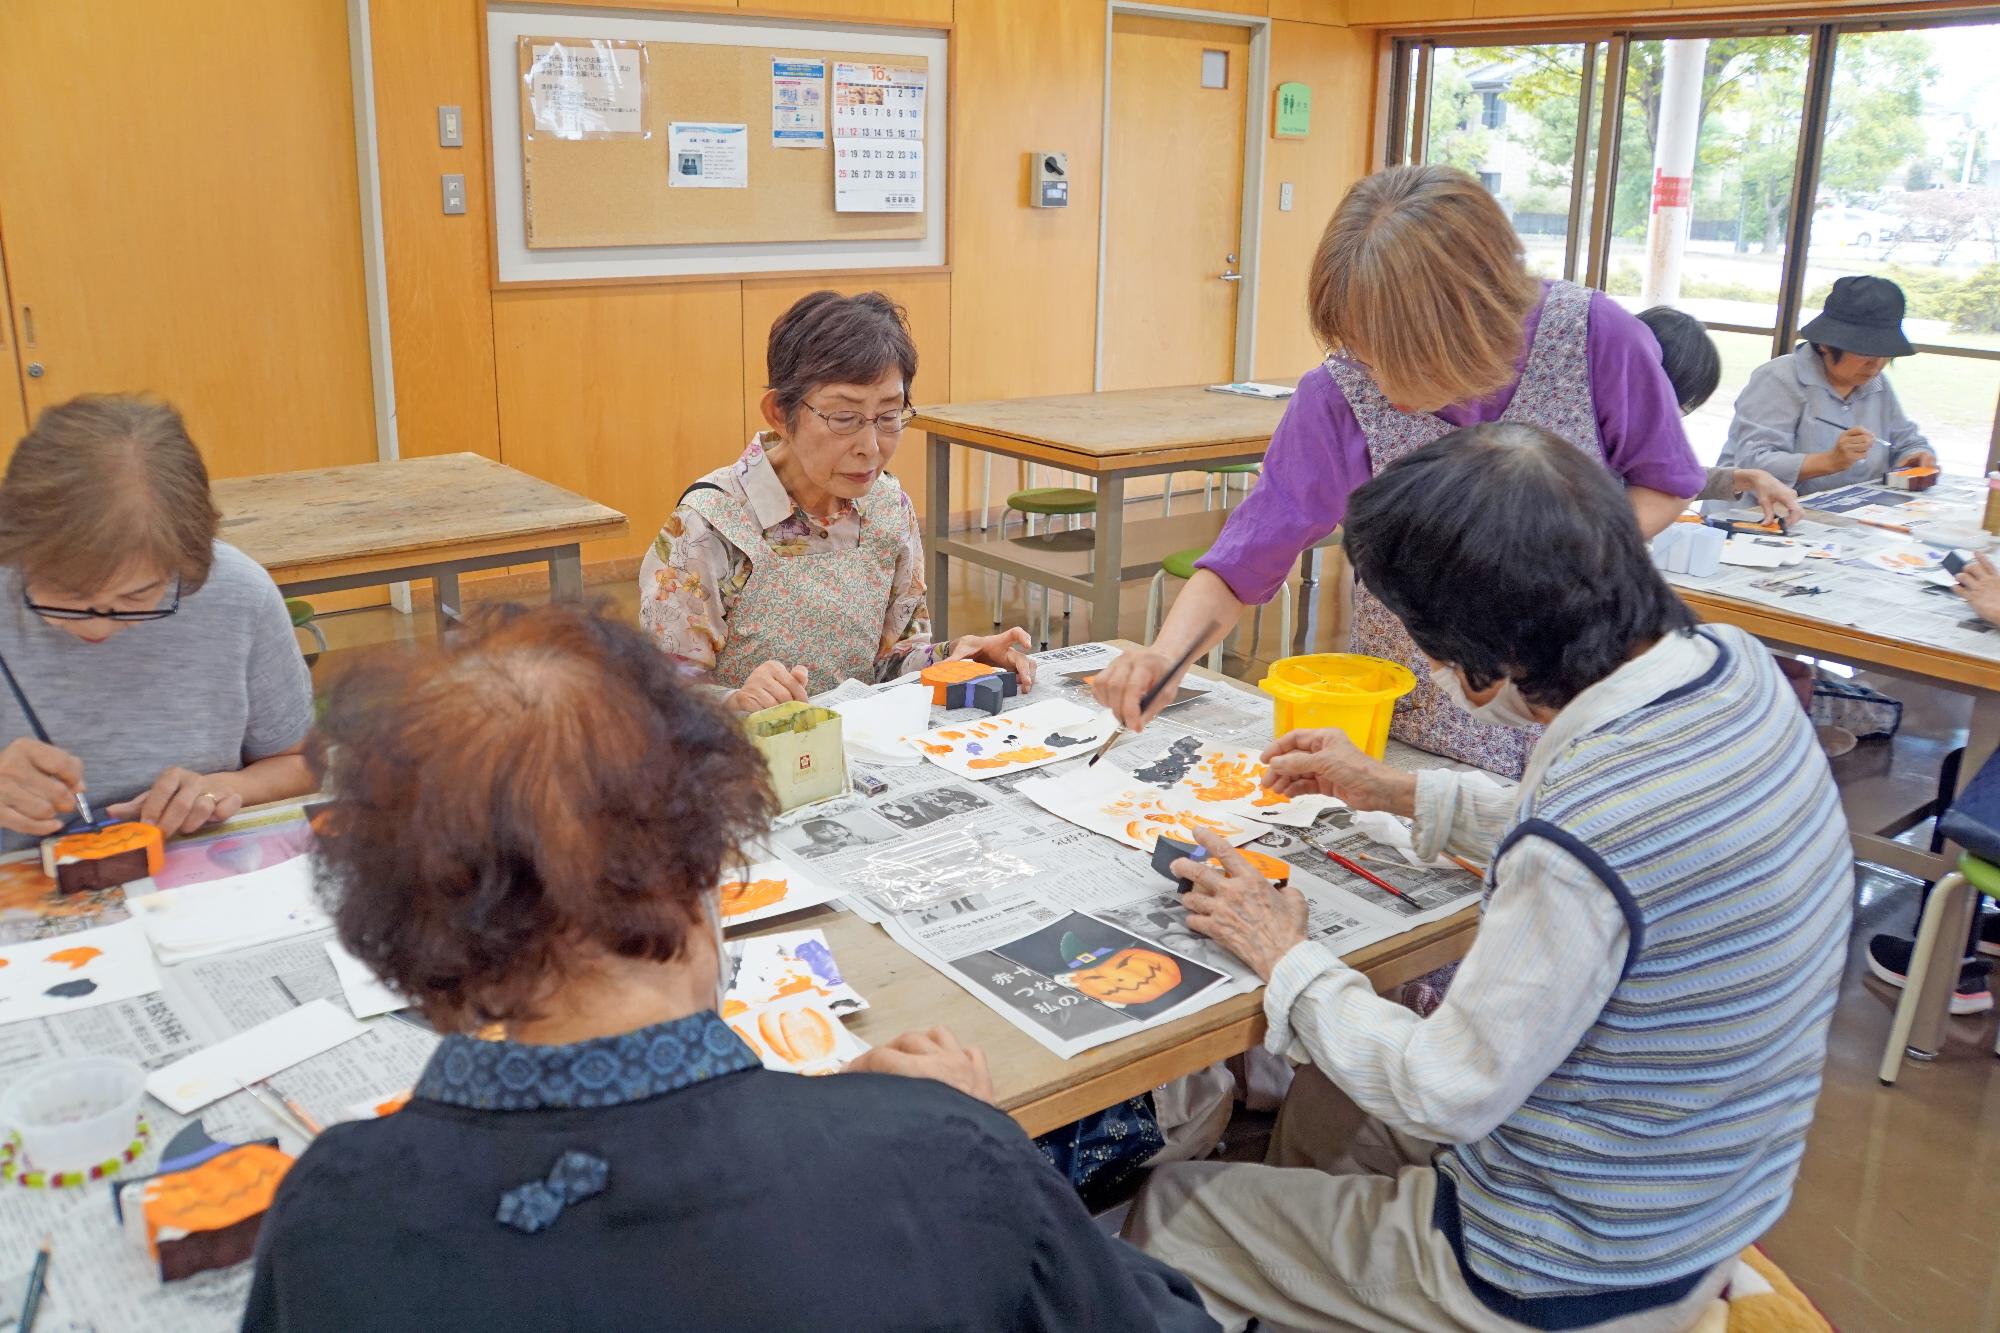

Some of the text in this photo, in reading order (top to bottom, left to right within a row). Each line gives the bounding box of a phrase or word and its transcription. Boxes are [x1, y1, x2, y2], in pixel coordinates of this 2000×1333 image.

[872, 68, 885, 81] 10
[886, 89, 916, 98] 1 2 3
[850, 107, 855, 116] 5
[862, 107, 867, 116] 6
[874, 108, 879, 117] 7
[886, 108, 891, 117] 8
[898, 109, 903, 118] 9
[909, 110, 917, 118] 10
[838, 127, 917, 138] 11 12 13 14 15 16 17
[838, 149, 917, 159] 18 19 20 21 22 23 24
[838, 170, 917, 179] 25 26 27 28 29 30 31
